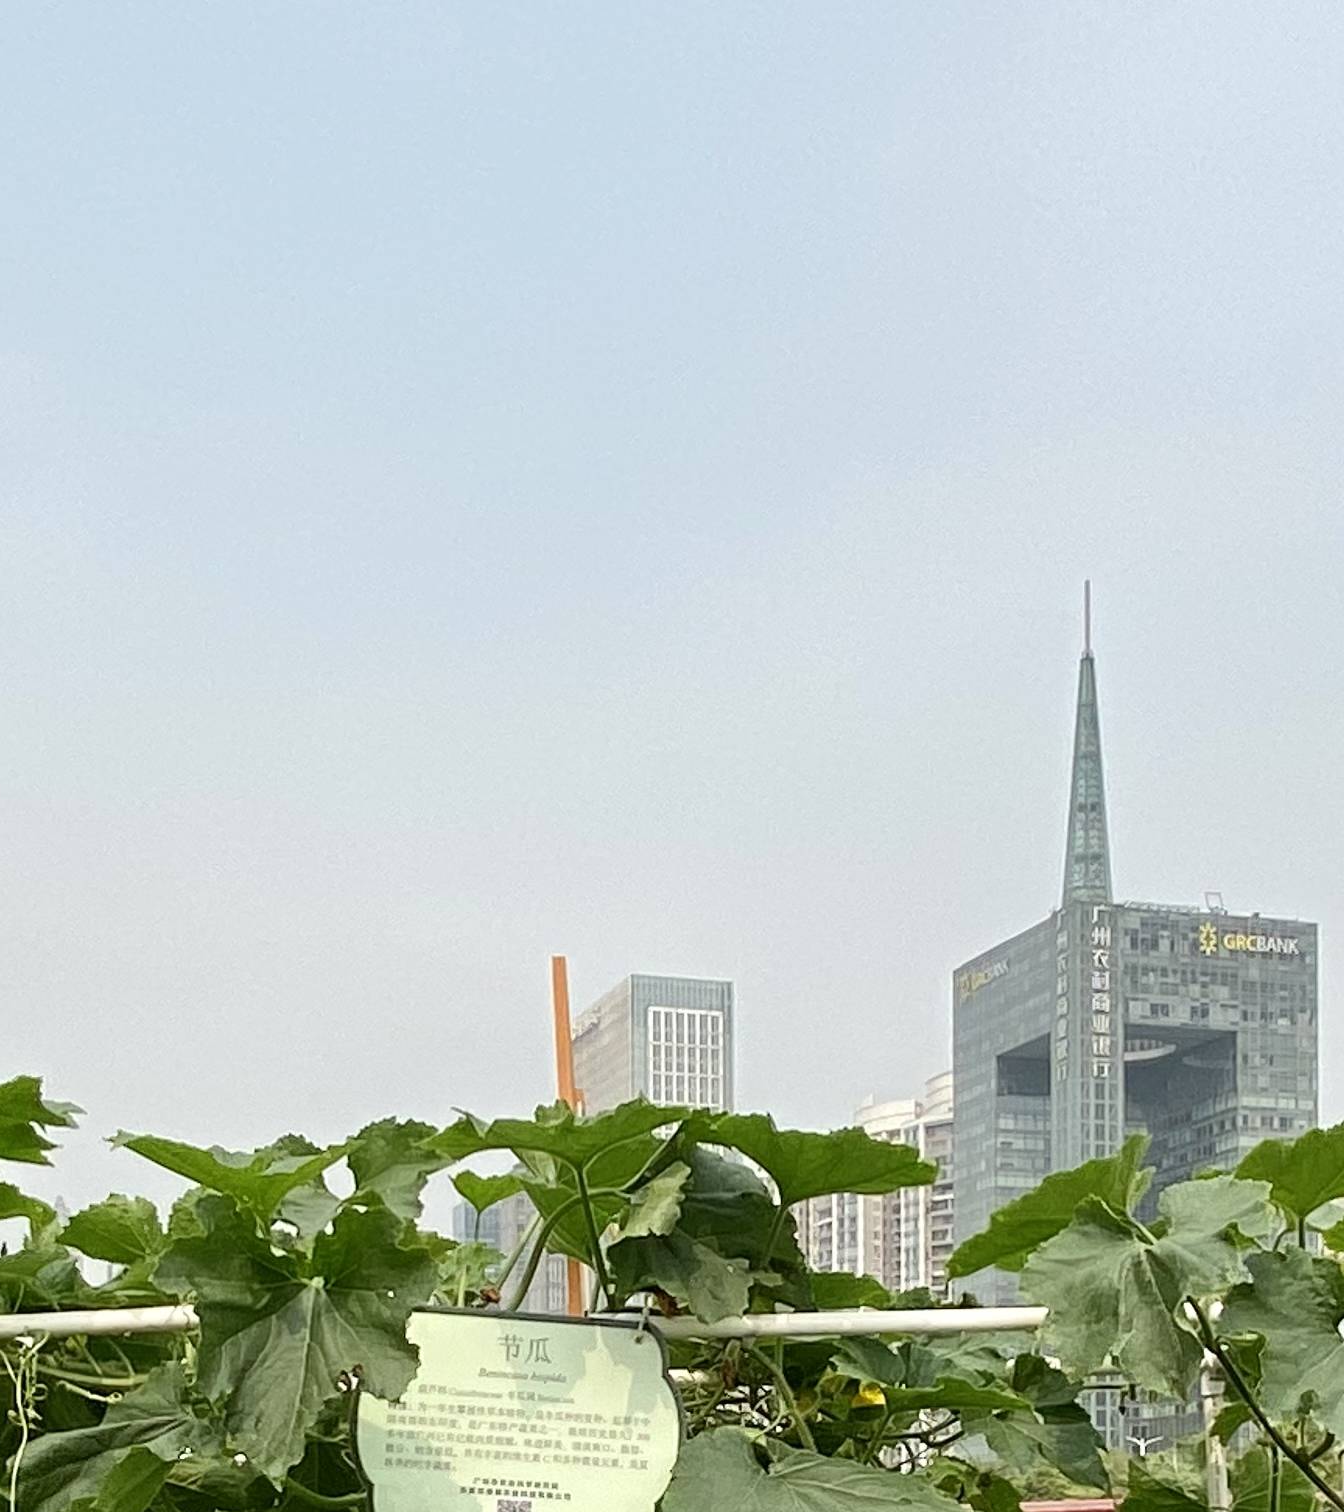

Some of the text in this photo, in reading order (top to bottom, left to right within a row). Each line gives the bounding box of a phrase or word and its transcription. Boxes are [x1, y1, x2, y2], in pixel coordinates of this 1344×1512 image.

[1223, 933, 1299, 955] GRCBANK
[1091, 905, 1112, 1079] 广州农村商业银行
[497, 1333, 553, 1365] 节瓜
